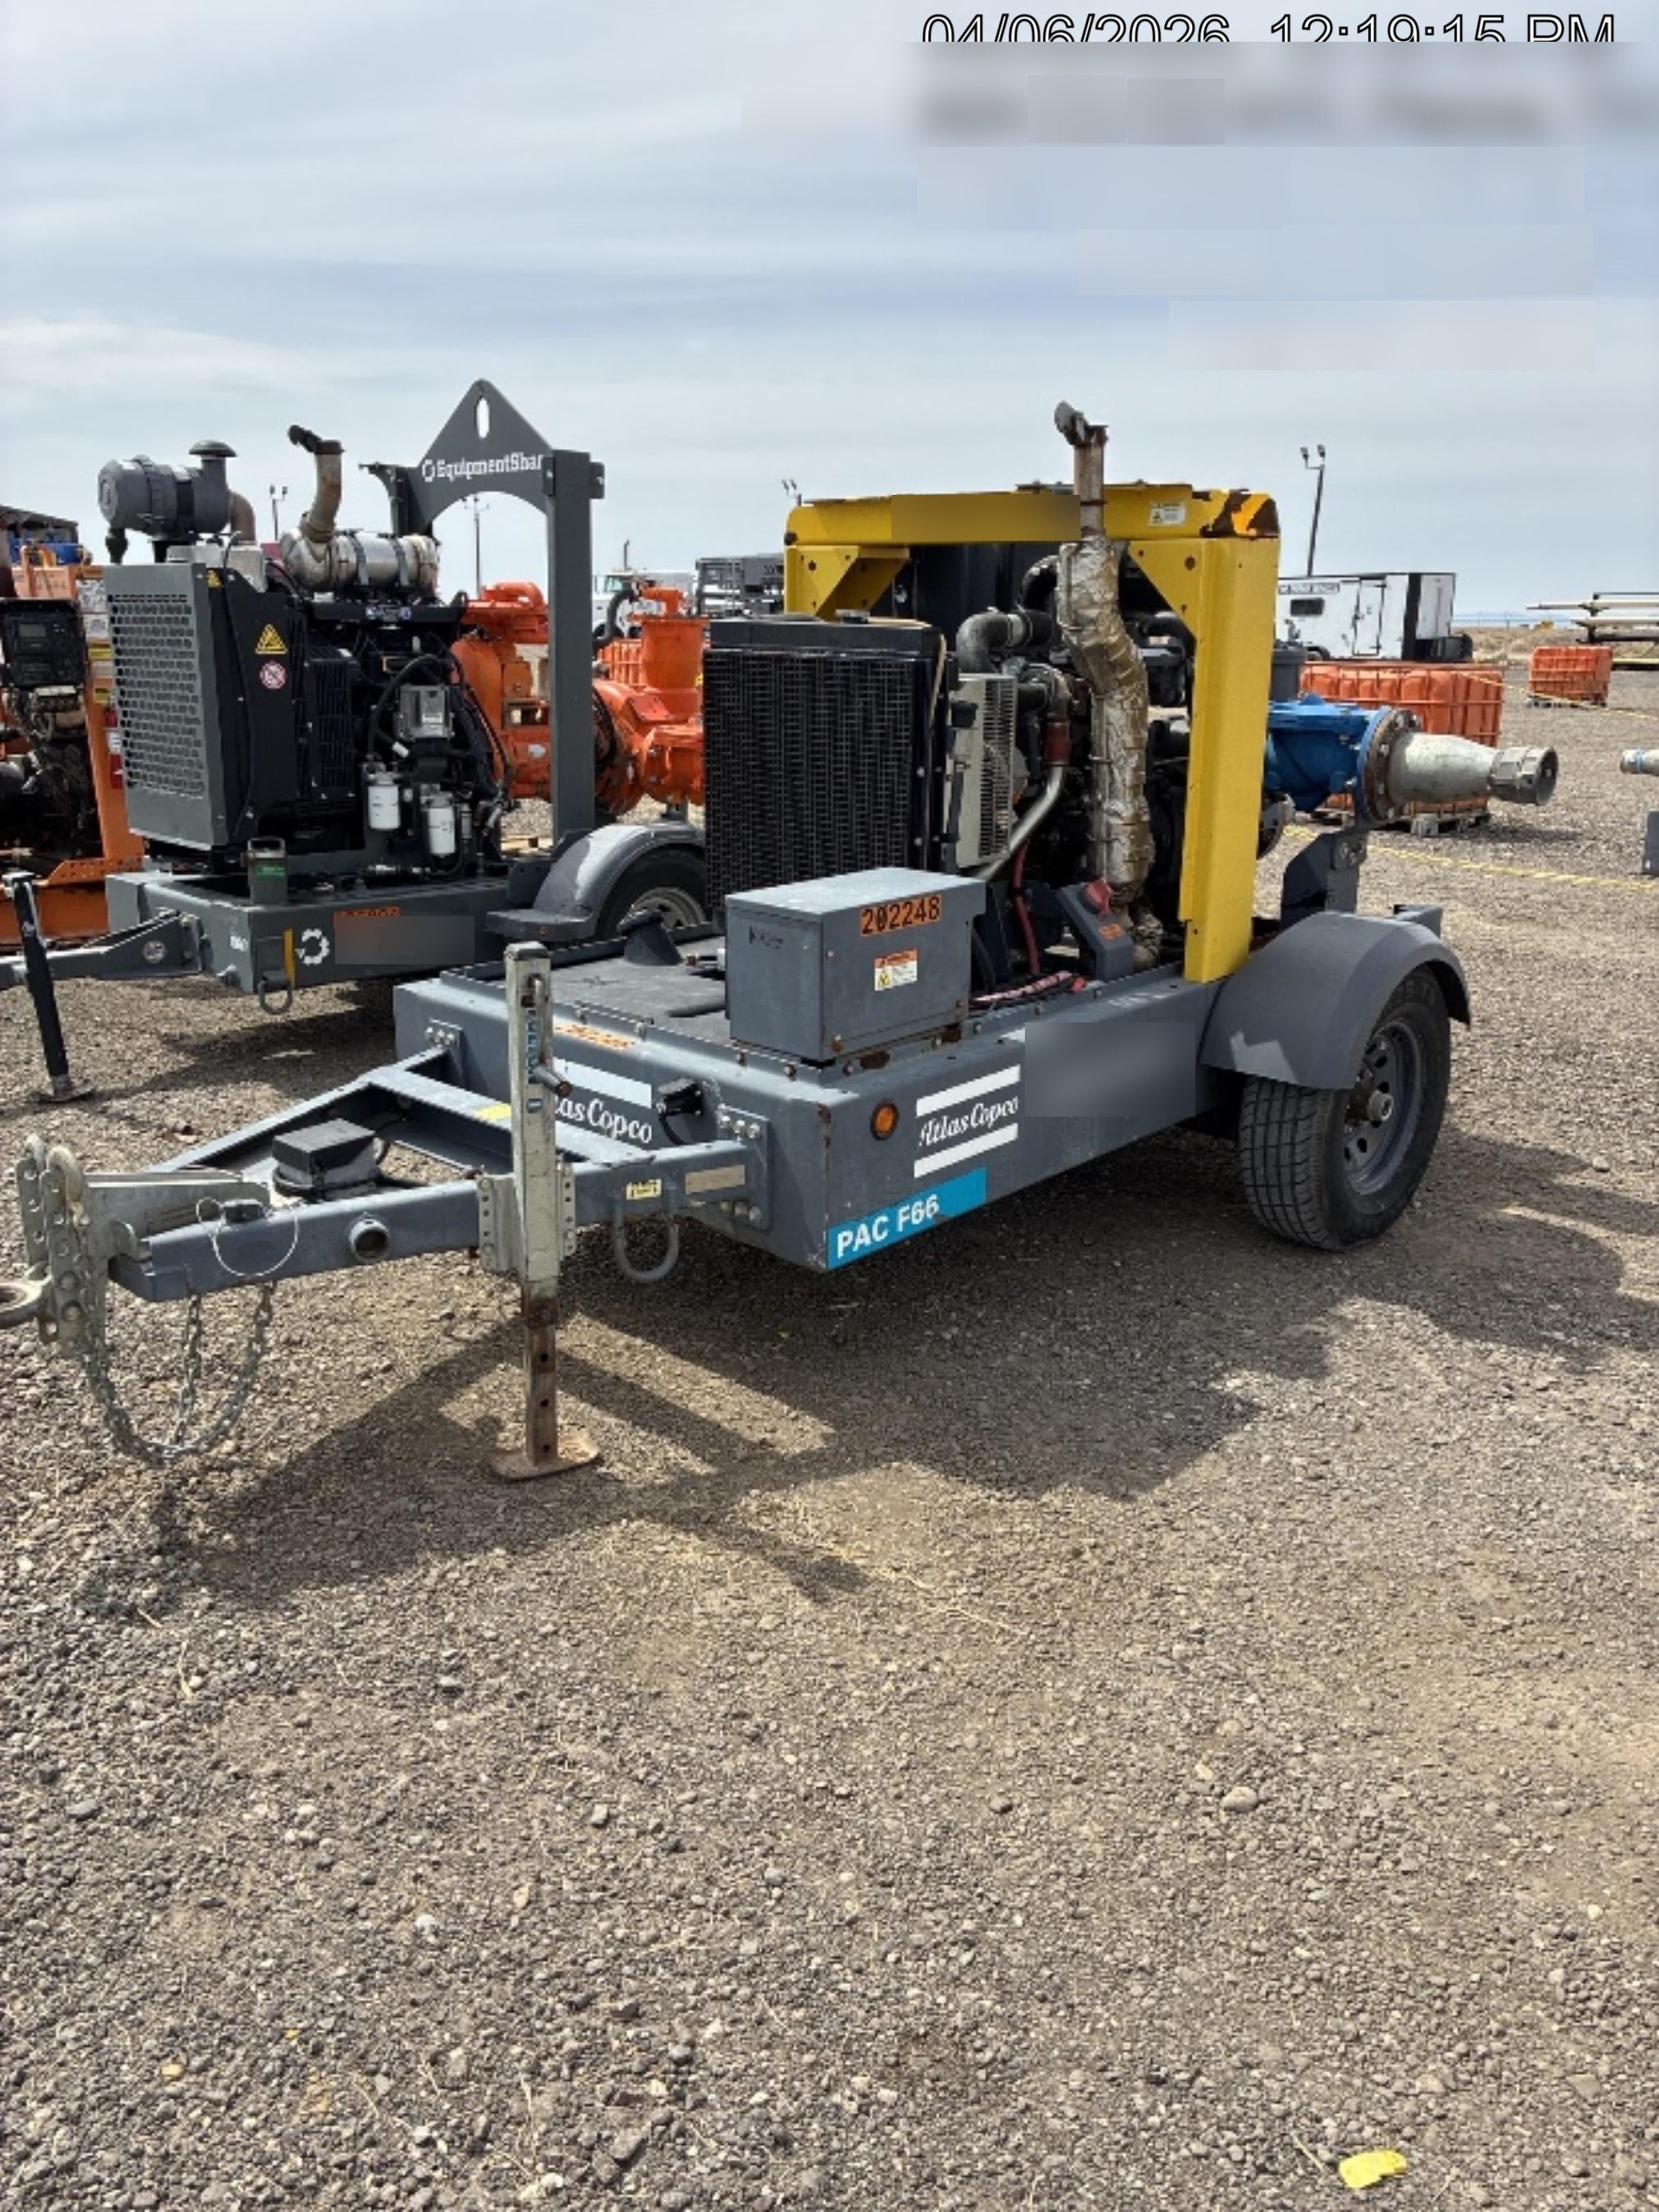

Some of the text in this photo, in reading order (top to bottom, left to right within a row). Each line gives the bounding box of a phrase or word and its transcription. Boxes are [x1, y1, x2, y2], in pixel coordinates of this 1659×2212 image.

[436, 451, 545, 483] EquipmentShar
[861, 895, 941, 935] 202248
[587, 1098, 653, 1144] Copco
[918, 1096, 1018, 1146] Atlas Copco
[836, 1193, 941, 1259] PAC F66
